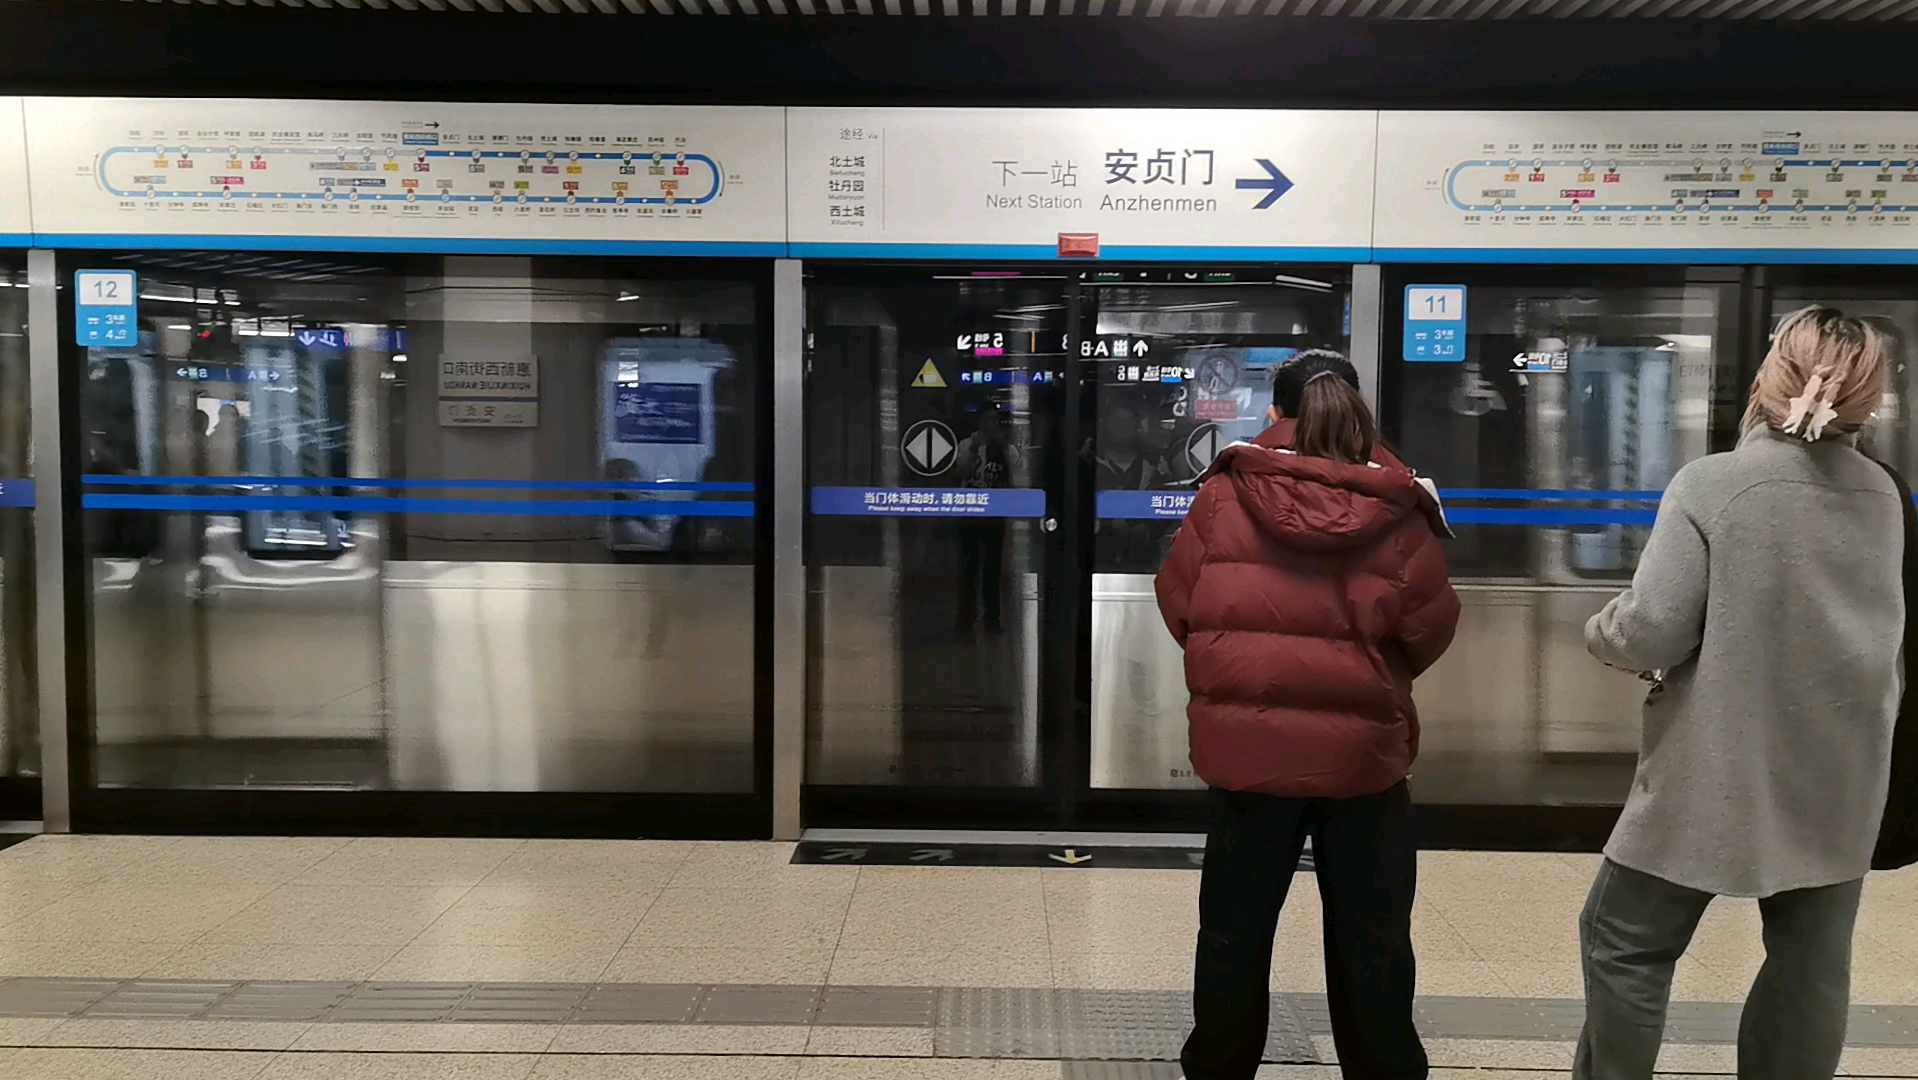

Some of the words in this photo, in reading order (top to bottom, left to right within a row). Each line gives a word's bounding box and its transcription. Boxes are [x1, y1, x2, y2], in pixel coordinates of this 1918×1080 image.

[840, 128, 863, 140] 途经
[829, 155, 865, 167] 北土城
[992, 159, 1078, 188] 下一站
[1105, 148, 1214, 186] 安贞门
[828, 180, 864, 192] 牡丹园
[986, 194, 1022, 209] Next
[1027, 194, 1082, 209] Station
[1099, 194, 1217, 212] Anzhenmen
[829, 205, 865, 217] 西土城
[94, 280, 118, 298] 12
[1425, 295, 1446, 314] 11
